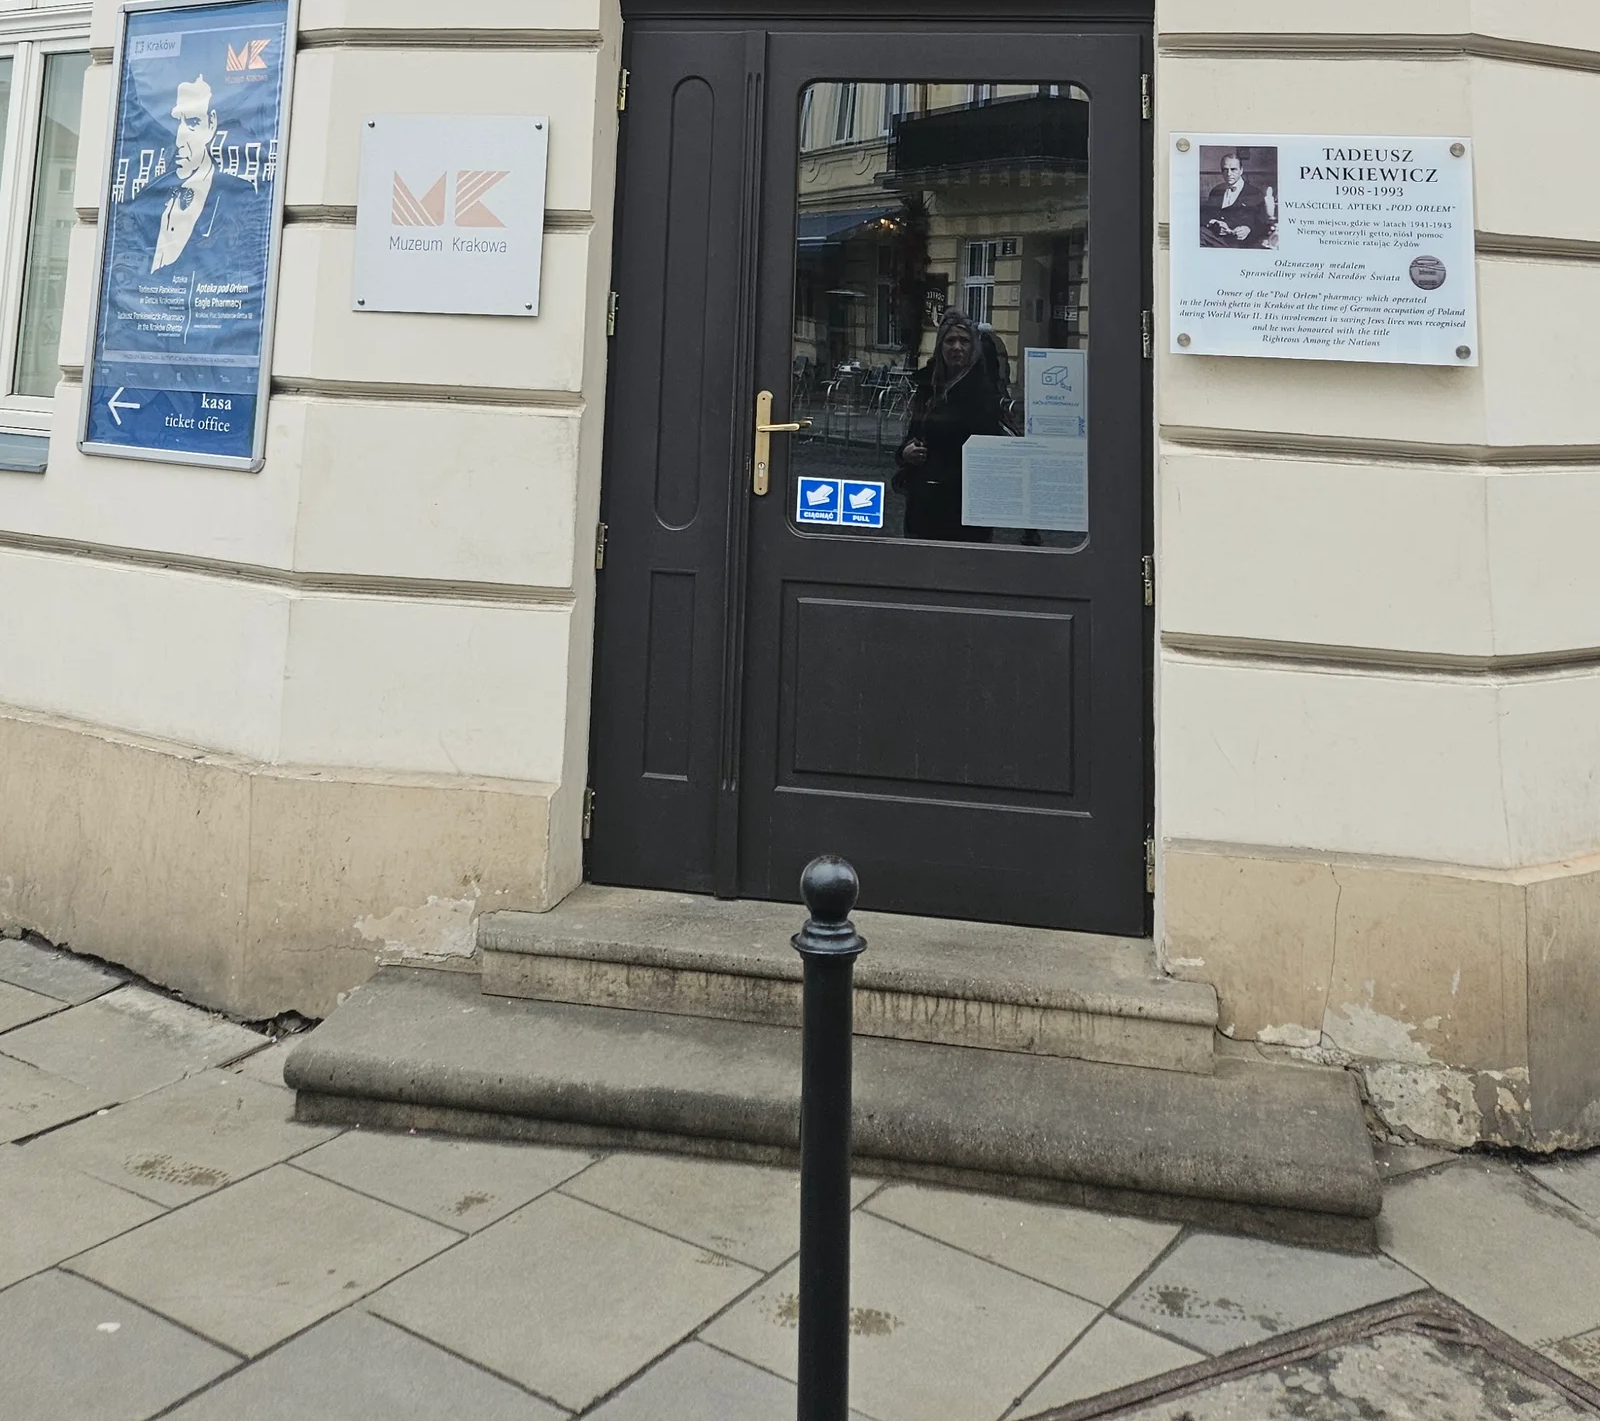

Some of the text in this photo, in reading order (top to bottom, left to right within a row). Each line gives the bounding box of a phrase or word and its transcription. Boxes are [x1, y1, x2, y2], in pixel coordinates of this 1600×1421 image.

[147, 39, 176, 51] Kraków
[1322, 147, 1414, 163] TADEUSZ
[1300, 166, 1438, 183] PANKIEWICZ
[1347, 203, 1381, 211] APTEKI
[1300, 219, 1315, 227] tym
[1318, 219, 1350, 227] miejscu,
[1350, 220, 1370, 228] gdzie
[1383, 220, 1407, 228] latach
[1410, 221, 1452, 229] 1941-1943
[1297, 228, 1327, 237] Niemcy
[1329, 229, 1366, 238] utworzyli
[1417, 232, 1443, 240] pomoc
[389, 235, 507, 253] Muzeum Krakowa
[1319, 238, 1360, 246] heroicznie
[1393, 239, 1420, 249] Żydów
[1274, 259, 1366, 270] Odznaczony medalem
[1239, 269, 1400, 282] Sprawiedliwy wśród Narodów Świata
[196, 283, 217, 295] Apteka
[217, 283, 230, 295] pod
[1217, 288, 1242, 297] Owner
[1245, 289, 1254, 299] of
[1256, 289, 1268, 298] the
[1323, 293, 1363, 302] pharmacy
[1366, 294, 1389, 302] which
[1392, 296, 1427, 305] operated
[195, 297, 242, 310] Eagle Pharmacy
[1179, 298, 1188, 306] in
[1190, 298, 1202, 306] the
[1202, 299, 1227, 308] Jewish
[1228, 300, 1251, 309] ghetto
[1264, 301, 1294, 310] Kraków
[1307, 302, 1319, 311] the
[1321, 304, 1338, 312] time
[1340, 304, 1348, 313] of
[1349, 304, 1381, 313] German
[1383, 306, 1425, 316] occupation
[1427, 307, 1436, 317] of
[1437, 308, 1465, 316] Poland
[1179, 310, 1205, 319] during
[1207, 310, 1231, 318] World
[1233, 311, 1250, 319] War
[1252, 312, 1262, 320] II.
[1264, 312, 1279, 320] His
[1281, 313, 1327, 323] involvement
[1330, 315, 1338, 323] in
[1340, 315, 1366, 325] saving
[1367, 316, 1385, 325] Jews
[1387, 317, 1405, 326] lives
[1425, 319, 1466, 329] recognised
[1269, 324, 1278, 332] he
[1297, 325, 1334, 334] honoured
[1336, 327, 1354, 335] with
[1358, 327, 1370, 335] the
[1373, 328, 1390, 336] title
[1262, 334, 1380, 347] Righteous Among the Nations
[201, 393, 232, 411] kasa
[165, 413, 230, 432] ticket office
[803, 511, 834, 520] CIĄGNĄĆ
